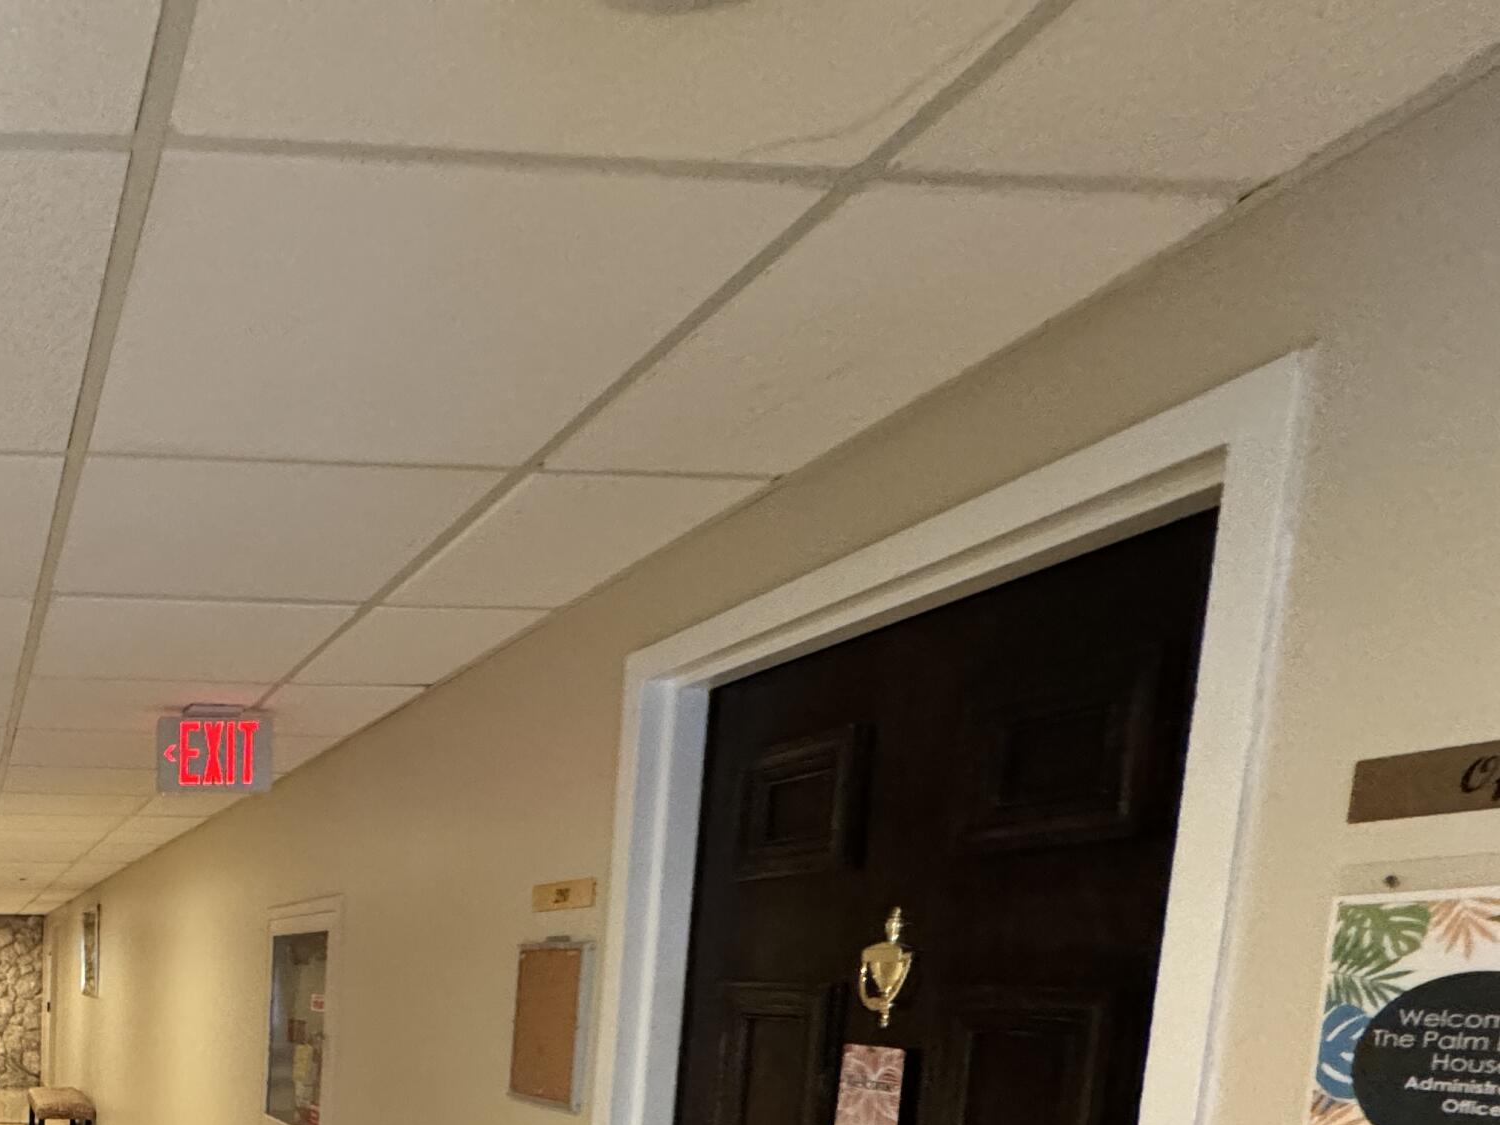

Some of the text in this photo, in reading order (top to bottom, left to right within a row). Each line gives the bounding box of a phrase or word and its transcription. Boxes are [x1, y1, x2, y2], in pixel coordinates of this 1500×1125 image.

[178, 720, 260, 786] EXIT
[1372, 1028, 1415, 1048] The
[1422, 1030, 1489, 1051] Palm
[1431, 1053, 1500, 1074] Hous
[1404, 1076, 1500, 1096] Administr
